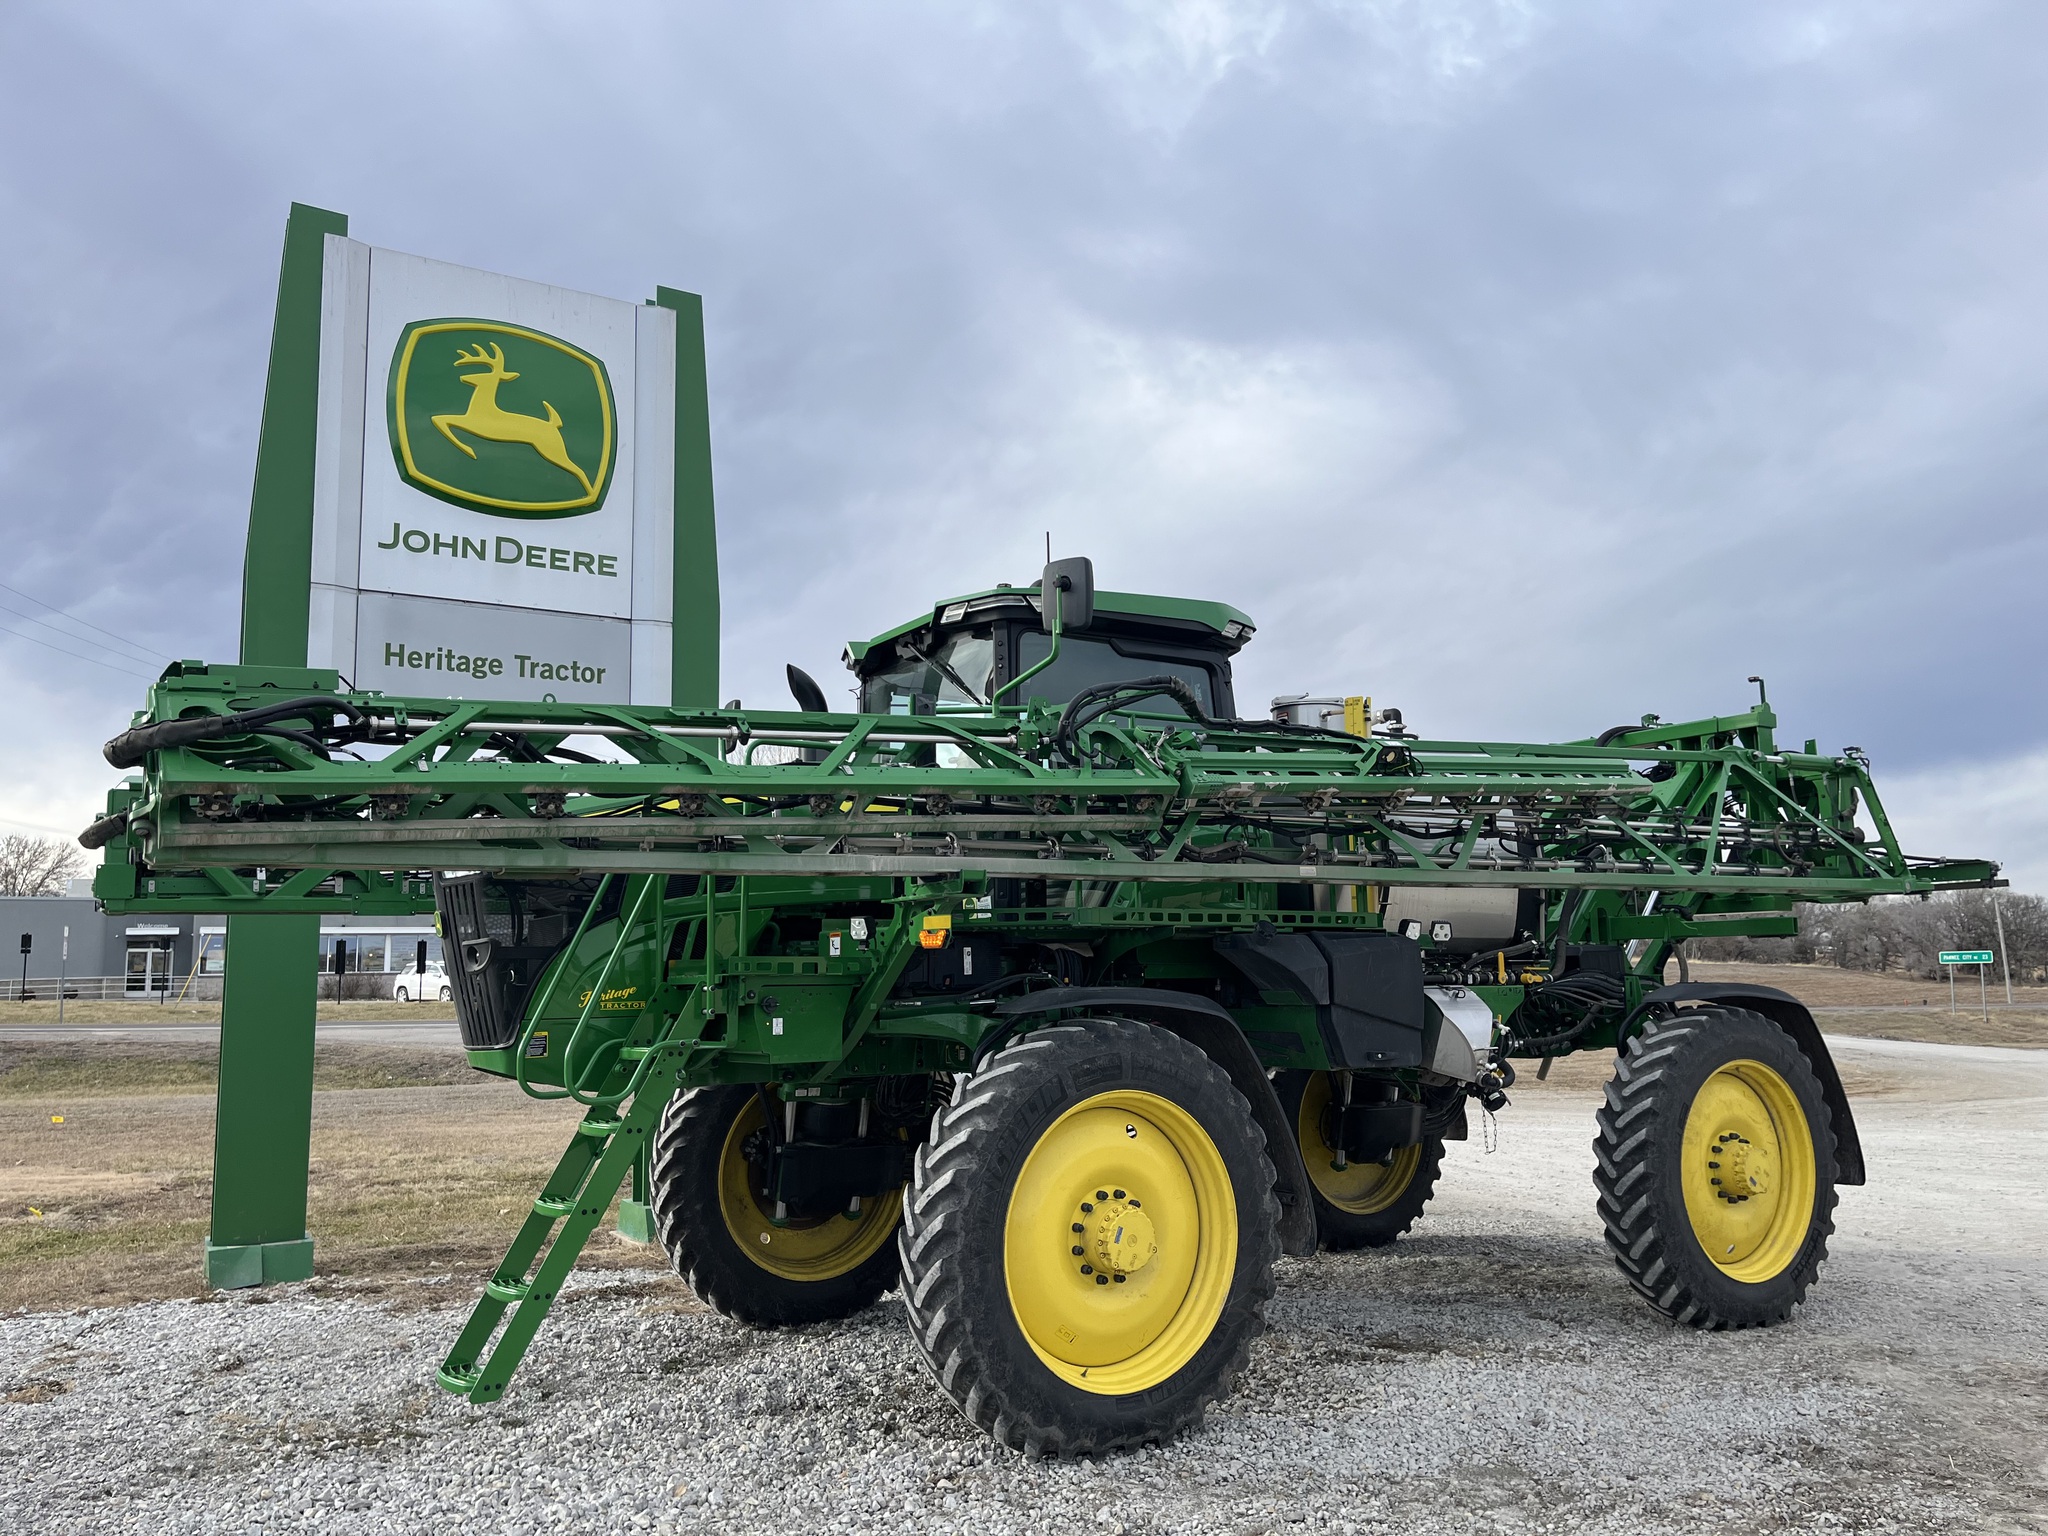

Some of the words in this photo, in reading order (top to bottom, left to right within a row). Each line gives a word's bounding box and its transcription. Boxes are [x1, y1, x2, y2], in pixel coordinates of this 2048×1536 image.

[378, 522, 487, 561] JOHN
[495, 536, 618, 578] DEERE
[384, 642, 503, 680] Heritage
[514, 654, 607, 684] Tractor
[579, 986, 637, 1008] Hritage
